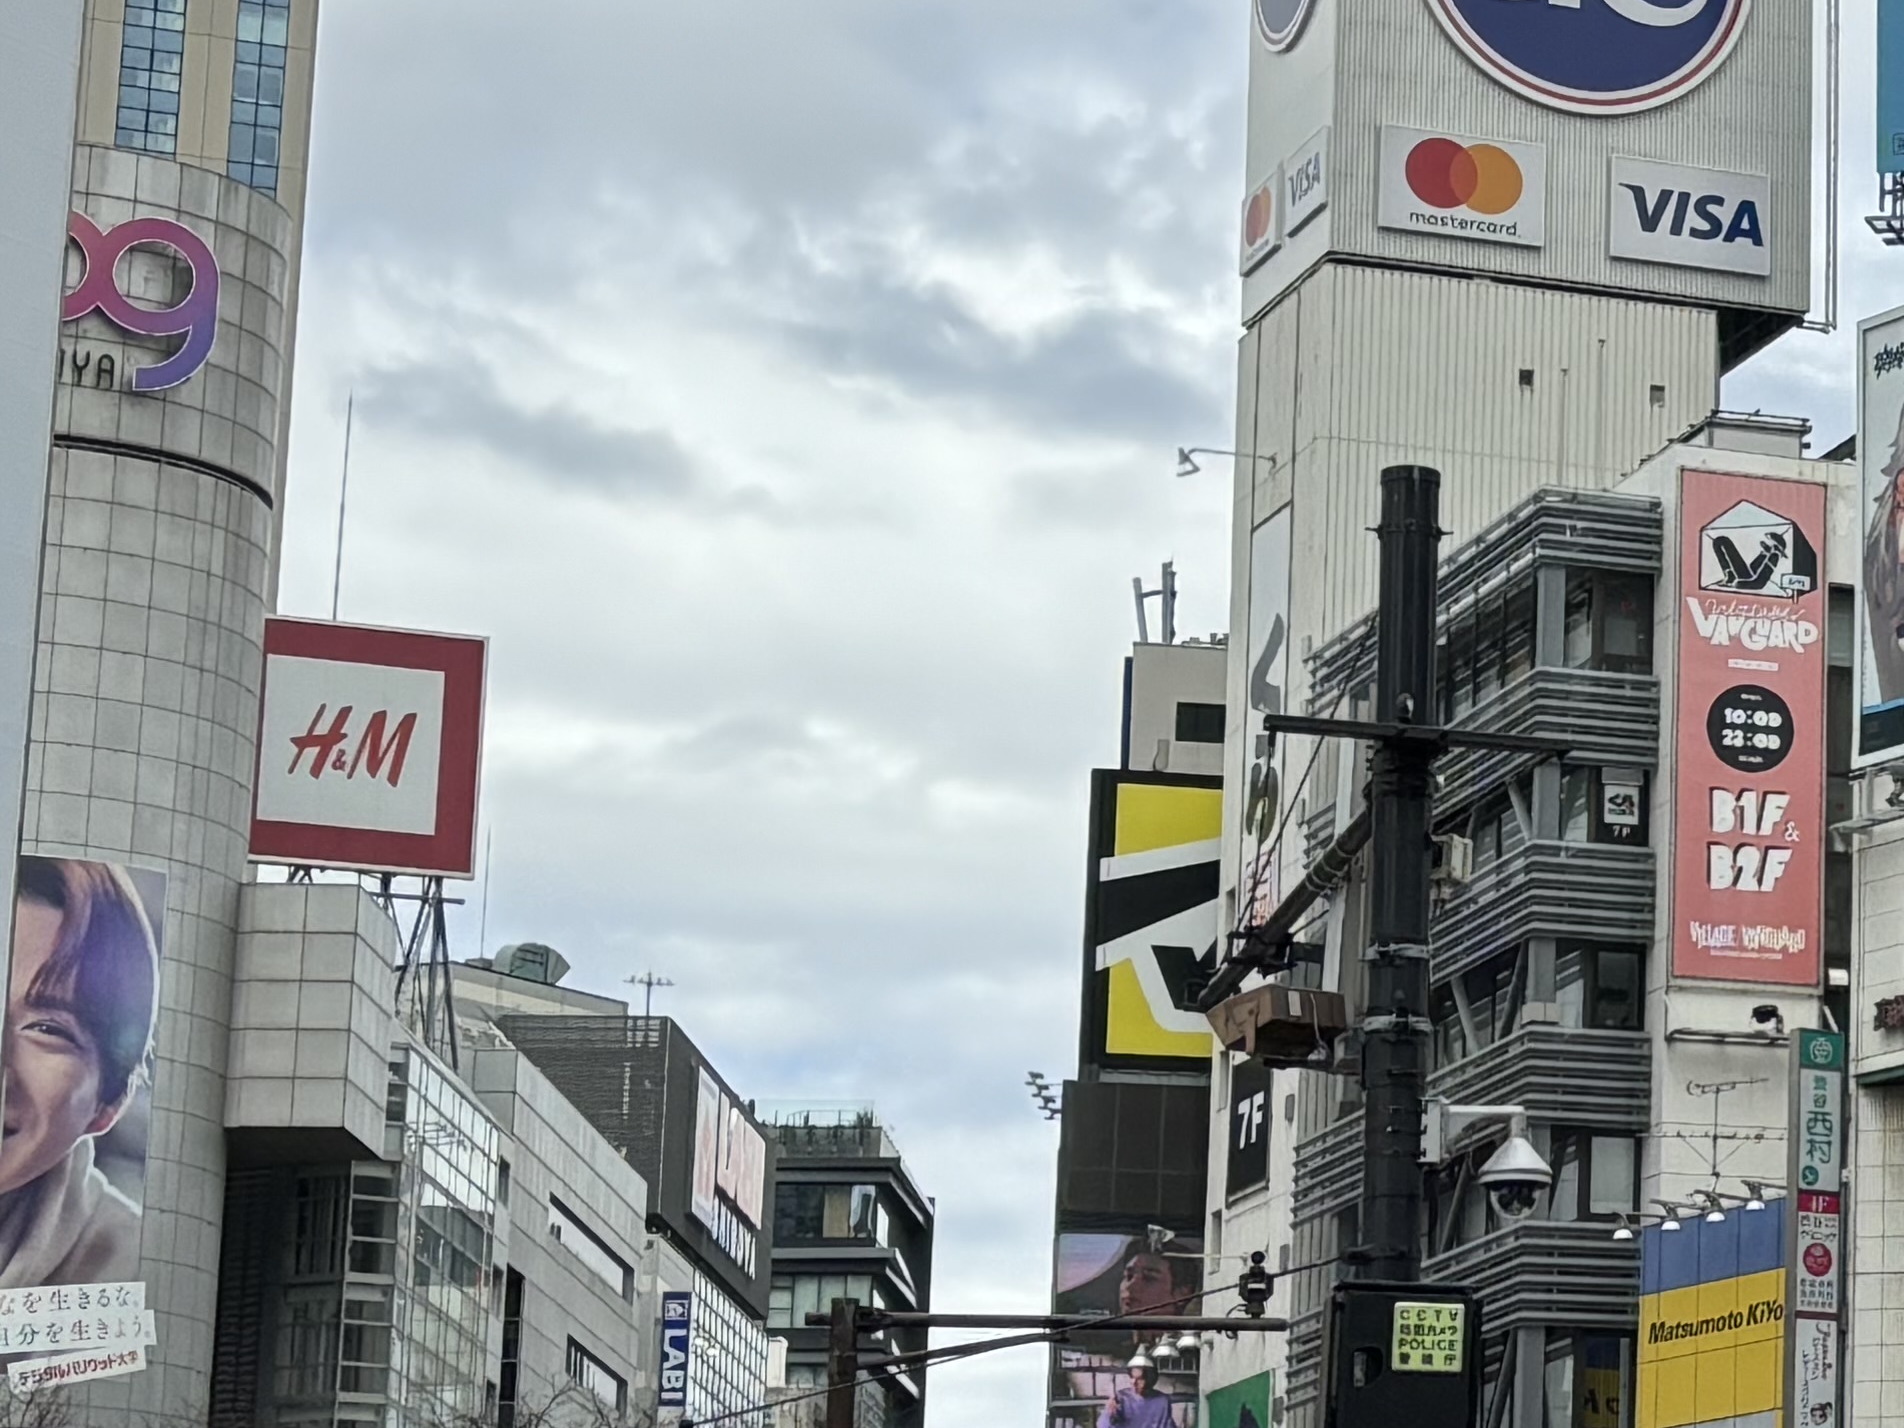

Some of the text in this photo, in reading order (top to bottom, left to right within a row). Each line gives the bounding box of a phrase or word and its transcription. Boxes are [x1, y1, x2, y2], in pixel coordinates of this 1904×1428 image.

[1408, 209, 1521, 238] mastercard
[1617, 182, 1764, 248] VISA
[56, 346, 116, 390] YA
[287, 702, 417, 789] H&M
[1709, 786, 1790, 837] B1F
[1707, 841, 1793, 892] B2F
[1236, 1090, 1265, 1152] 7F
[1397, 1338, 1459, 1352] POLICE
[1648, 1308, 1744, 1346] Matsumoto
[662, 1326, 686, 1404] LABI
